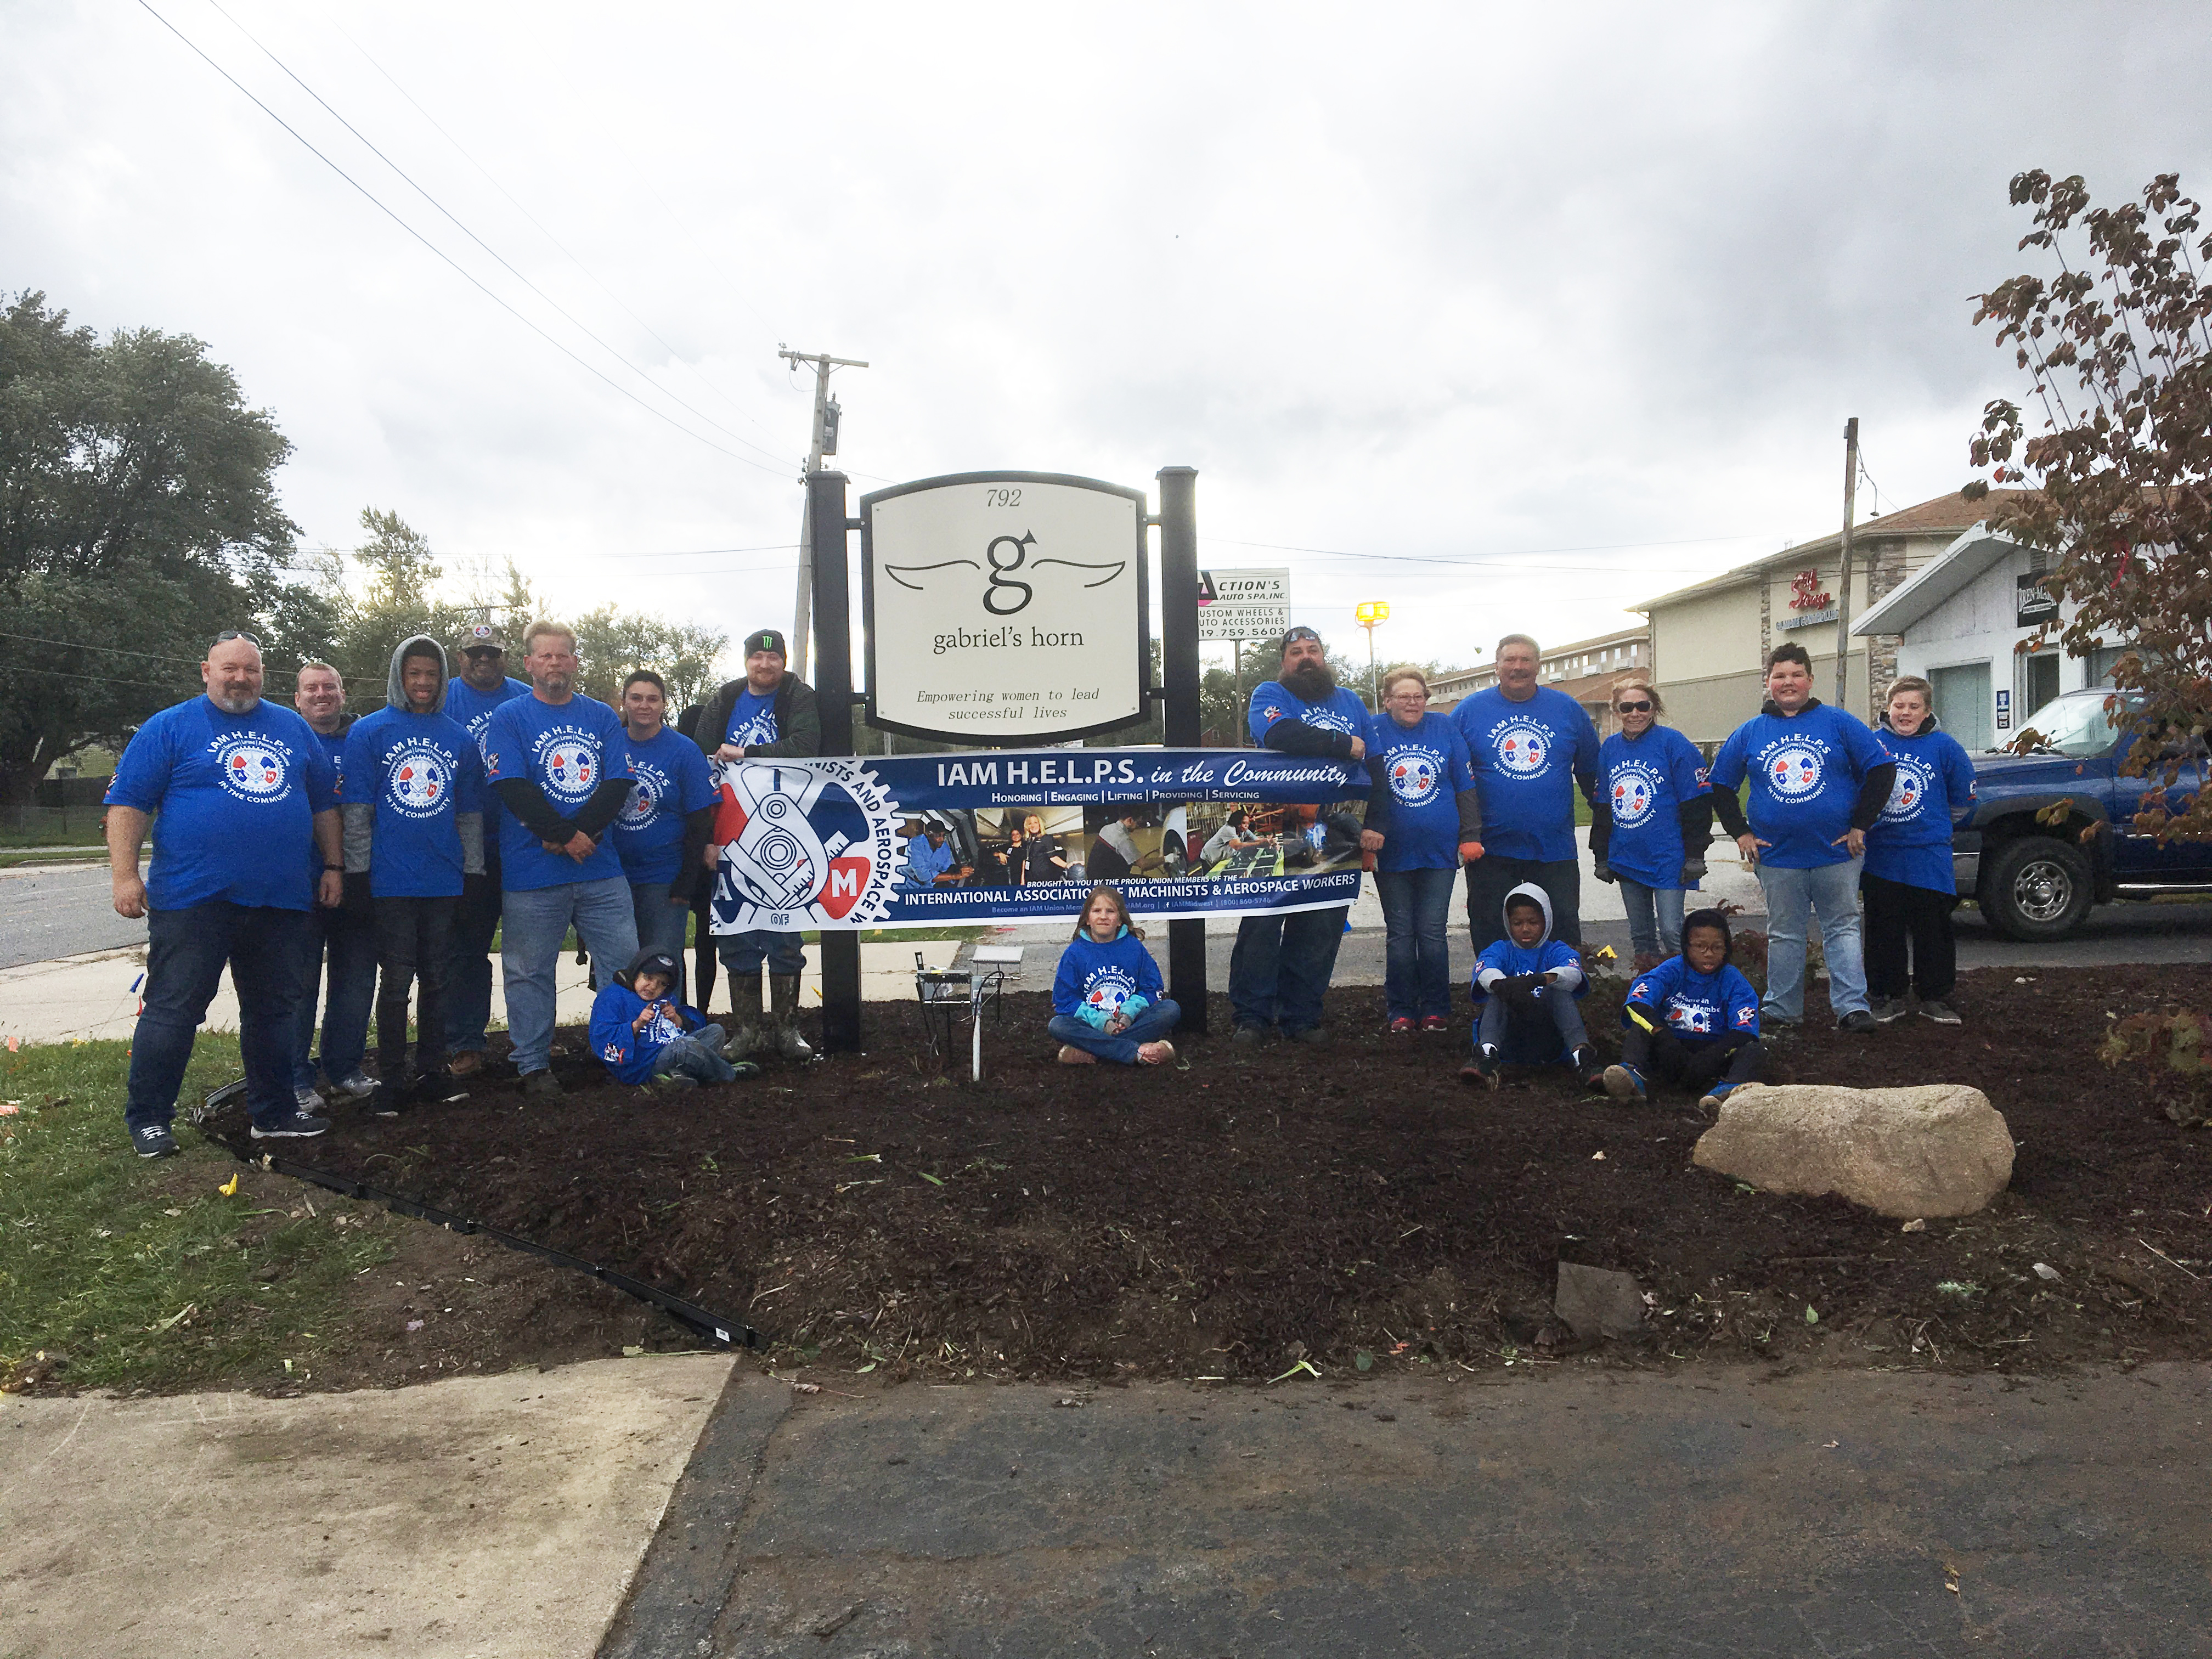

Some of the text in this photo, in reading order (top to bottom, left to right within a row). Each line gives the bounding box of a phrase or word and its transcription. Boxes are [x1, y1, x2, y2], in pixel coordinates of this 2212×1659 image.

[987, 489, 1022, 507] 792
[983, 529, 1038, 616] g
[1223, 617, 1285, 627] ACCESSORIES
[1237, 608, 1273, 617] WHEELS
[933, 626, 1085, 655] gabriel's horn
[1200, 628, 1285, 637] 19.759.5603
[917, 688, 1100, 704] Empowering women to lead
[949, 706, 1067, 720] successful lives
[466, 715, 483, 733] AM
[730, 722, 751, 742] IAM
[1487, 720, 1508, 738] IAM
[207, 734, 230, 752] IAM
[532, 731, 552, 753] IAM
[1757, 741, 1779, 761] IAM
[382, 741, 405, 765] IAM
[1384, 746, 1398, 762] AM
[634, 761, 670, 786] .E.L.P.S
[938, 759, 1348, 788] IAM H.E.L.P.S. in the Community
[1493, 761, 1553, 780] IN THE COMMUNITY
[218, 781, 293, 804] IN THE COMMUNITY
[540, 781, 547, 791] IN
[548, 790, 562, 801] THE
[992, 789, 1260, 803] HONORING ENGAGING LIFTING PROVIDING SERVICING
[1404, 787, 1441, 808] COMMUNITY
[1768, 780, 1827, 804] IN THE COMMUNITY
[385, 794, 451, 819] IN THE COMMUNITY
[1620, 808, 1657, 829] COMMUNITY
[851, 782, 892, 911] AND AEROSPACE
[713, 873, 733, 901] A
[831, 868, 857, 898] M
[905, 890, 1011, 905] INTERNATIONAL
[1014, 888, 1093, 902] ASSOCIATIO
[1128, 884, 1207, 898] MACHINISTS
[1212, 884, 1222, 895] &
[1224, 880, 1299, 895] AEROSPACE
[1302, 873, 1356, 890] WORKERS
[1027, 880, 1063, 888] BROUGHT
[771, 913, 789, 926] OF
[1692, 1003, 1720, 1013] Membe
